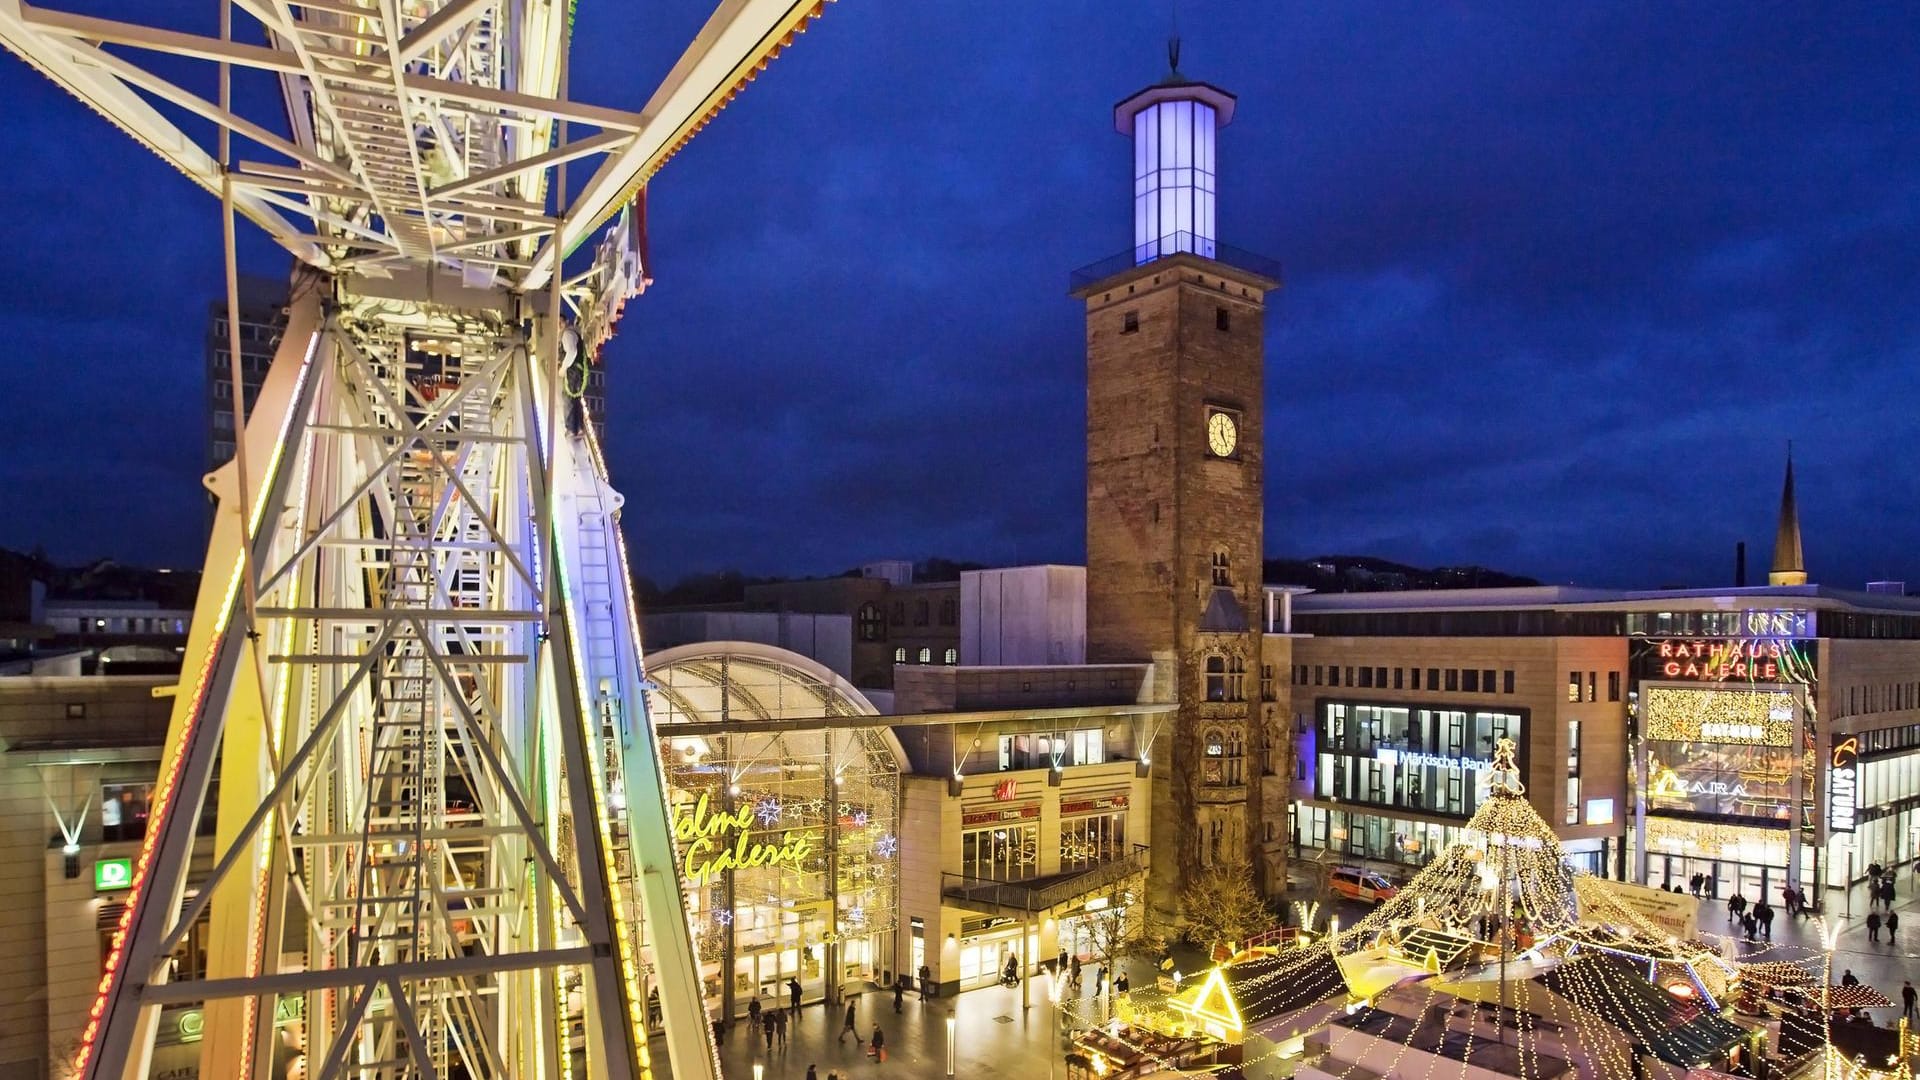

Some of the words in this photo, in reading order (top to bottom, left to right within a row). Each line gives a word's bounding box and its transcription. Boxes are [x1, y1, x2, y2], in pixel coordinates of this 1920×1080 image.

[1660, 643, 1781, 659] RATHAUS
[1664, 662, 1777, 678] GALERIE
[1400, 751, 1460, 769] Märkische
[1461, 757, 1493, 772] Bank
[1678, 779, 1749, 797] ZARA
[1831, 767, 1856, 830] SATURN
[684, 829, 813, 887] Galerie
